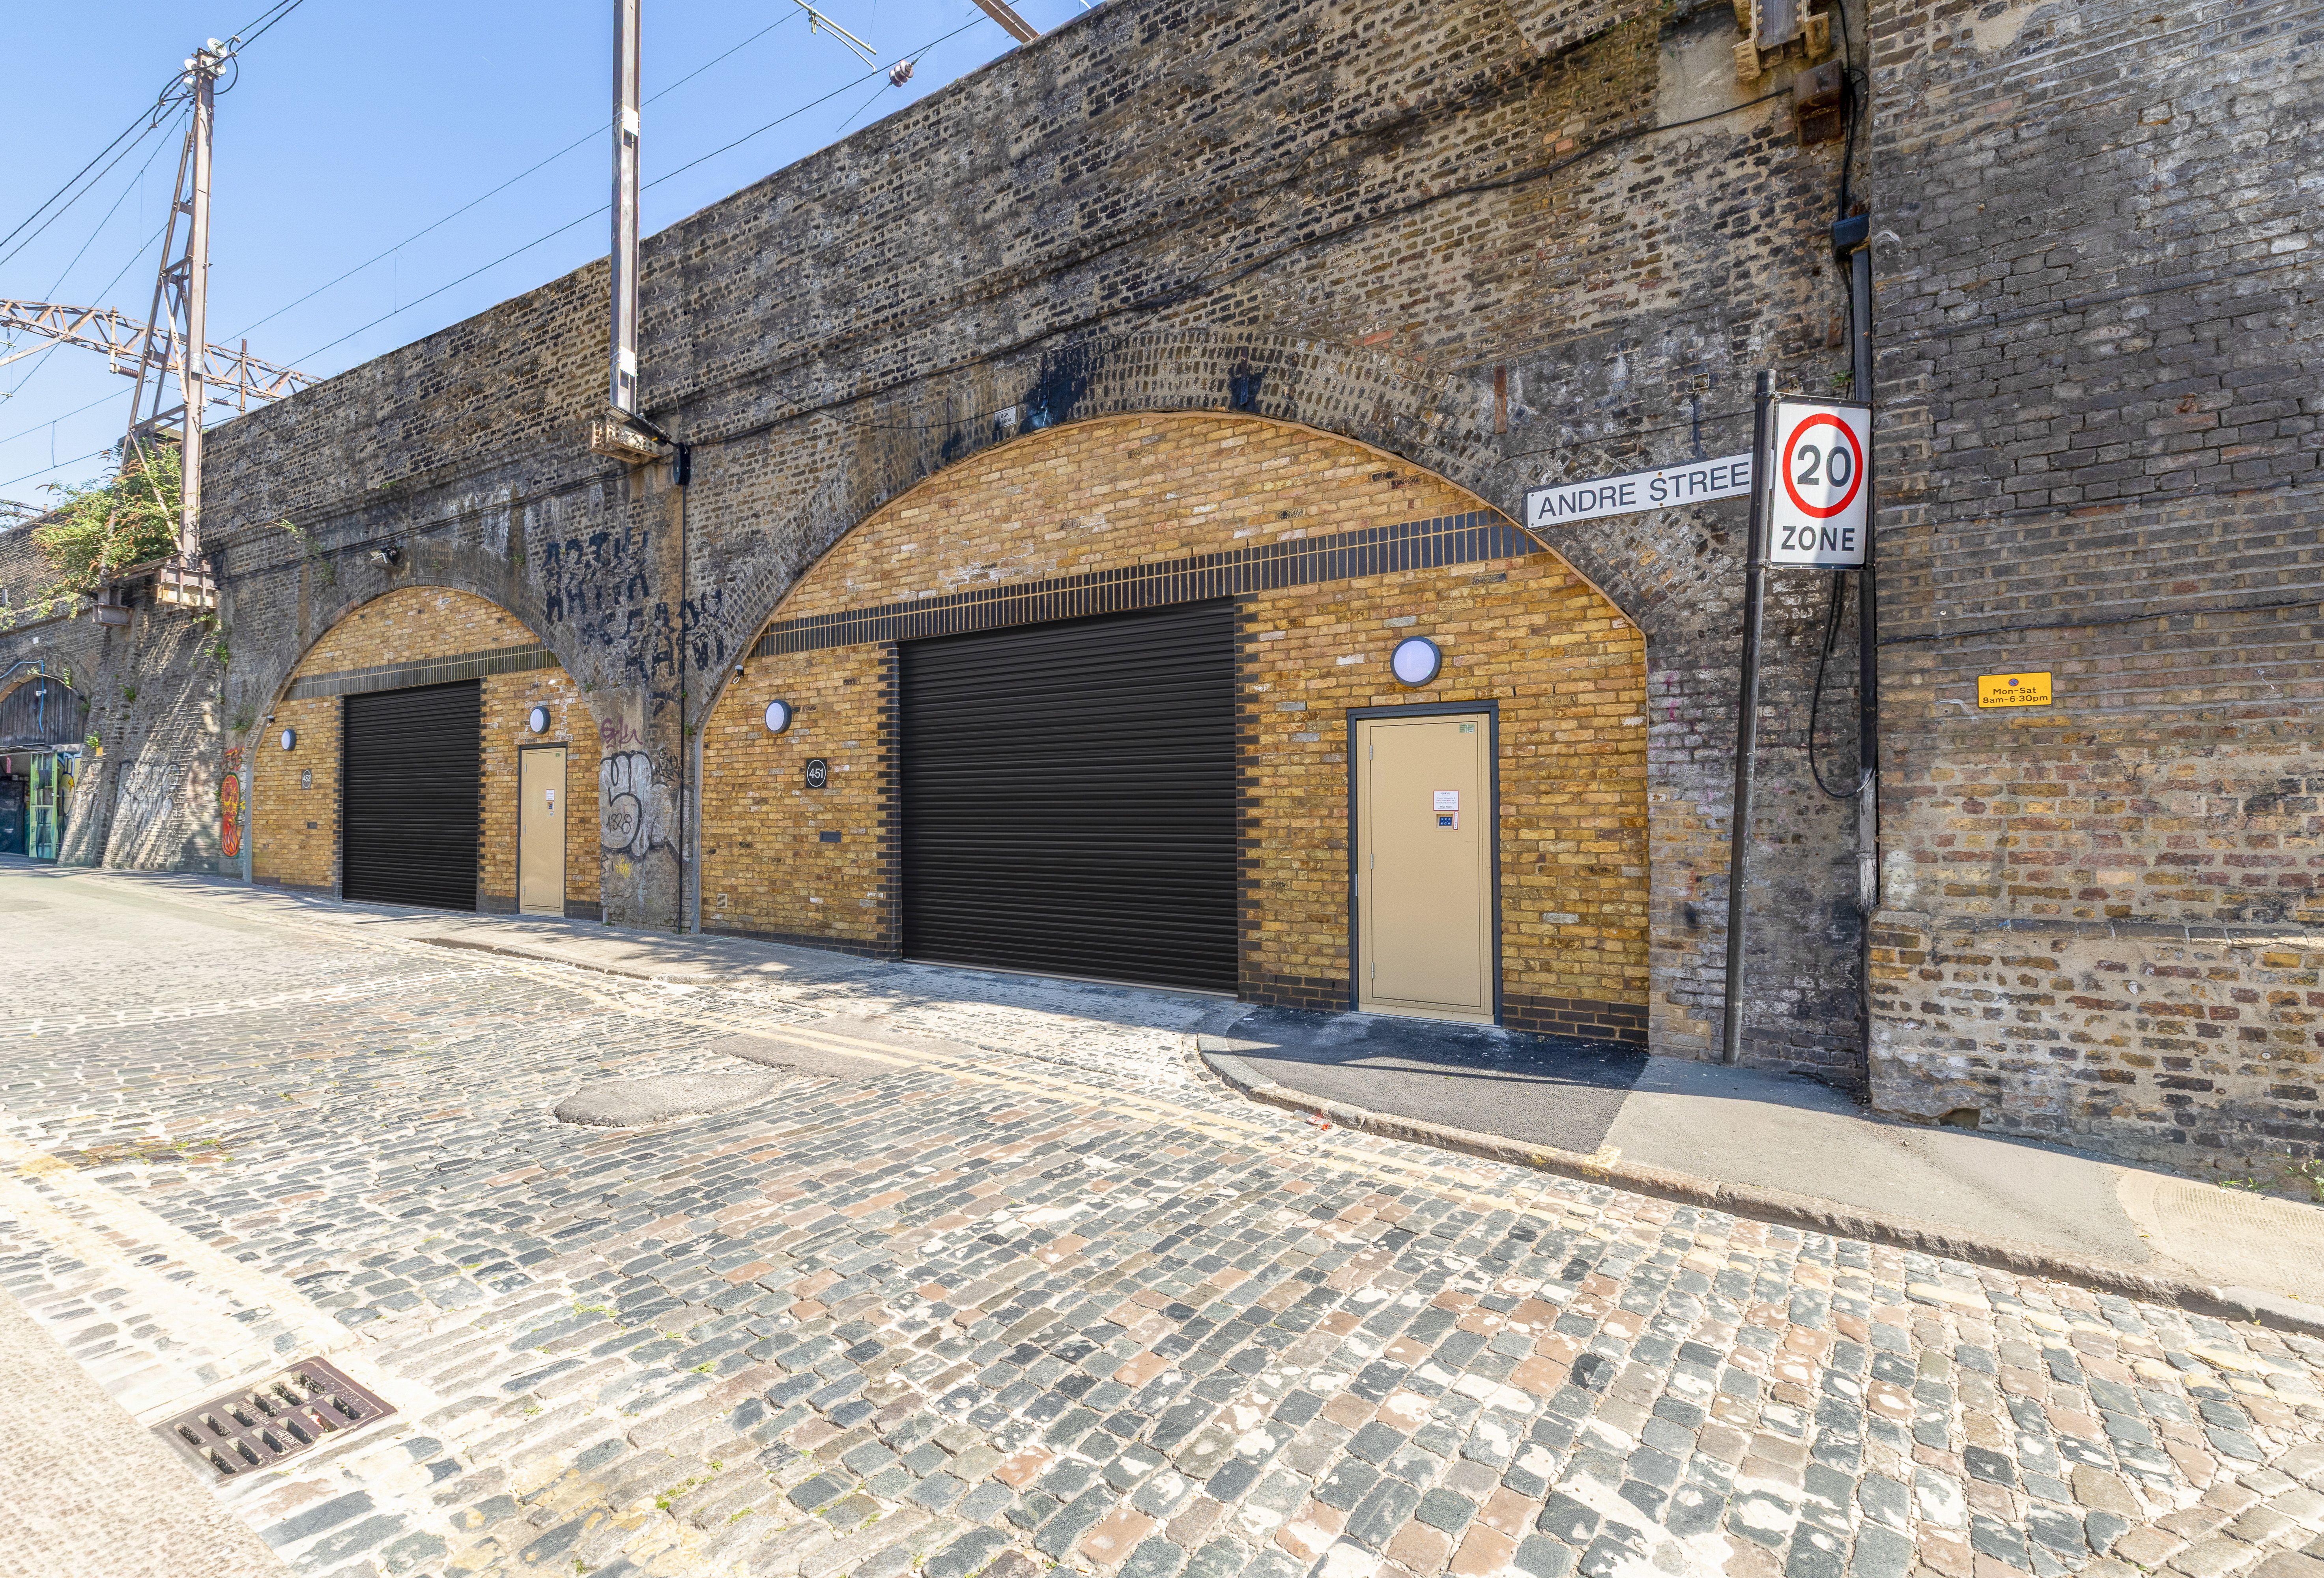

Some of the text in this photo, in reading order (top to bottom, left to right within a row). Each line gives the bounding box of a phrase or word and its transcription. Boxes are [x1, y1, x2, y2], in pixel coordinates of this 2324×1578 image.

[1797, 445, 1851, 488] 20
[1538, 461, 1751, 519] ANDRE STREE
[1781, 526, 1855, 552] ZONE
[809, 768, 823, 778] 451
[606, 813, 632, 834] 1328
